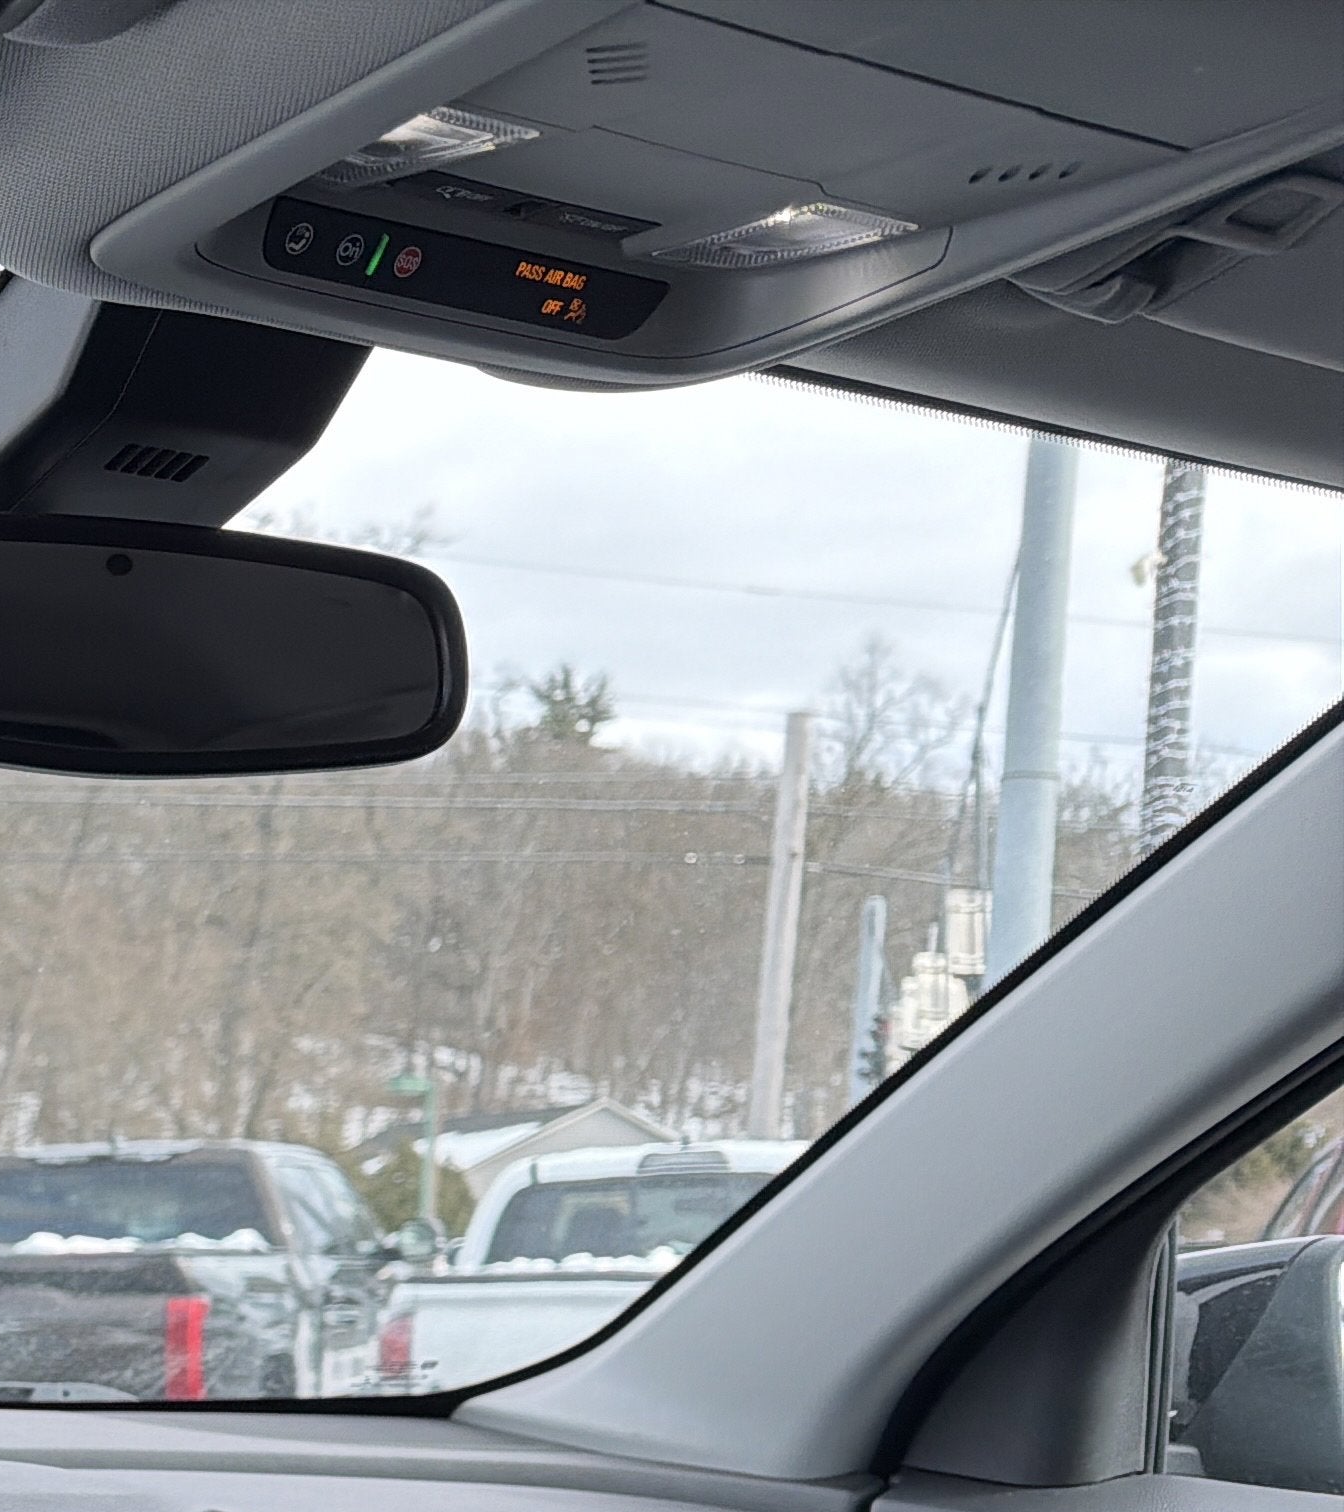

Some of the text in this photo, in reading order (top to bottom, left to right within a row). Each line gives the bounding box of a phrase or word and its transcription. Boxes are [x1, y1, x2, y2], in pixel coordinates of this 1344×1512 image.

[515, 261, 587, 291] PASS AIR BAG
[541, 299, 564, 316] OFF
